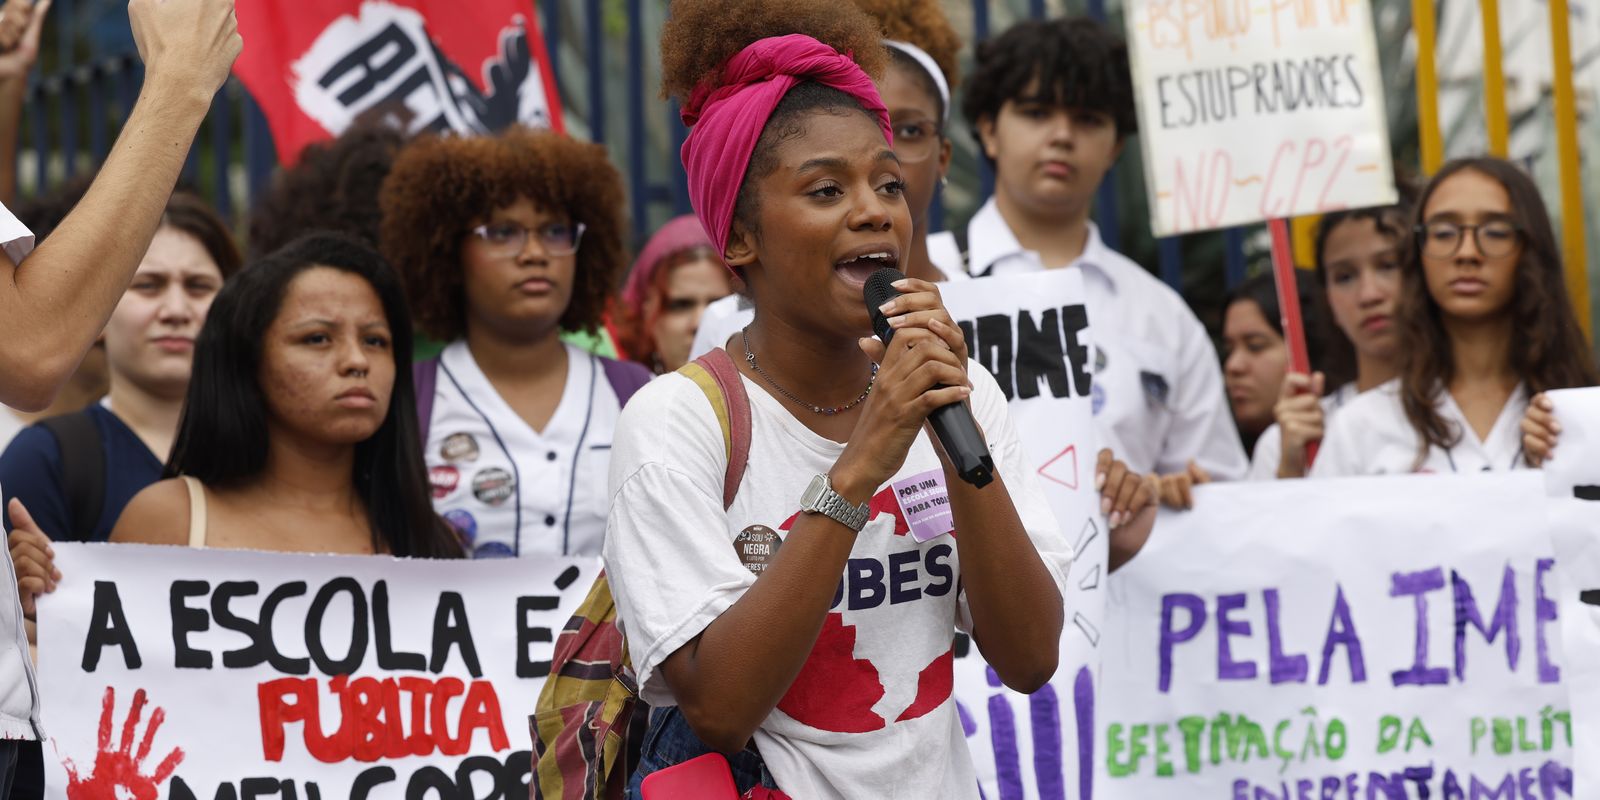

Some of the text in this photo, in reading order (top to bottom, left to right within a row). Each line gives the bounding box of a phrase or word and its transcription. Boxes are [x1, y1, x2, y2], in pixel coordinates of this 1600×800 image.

[1156, 54, 1364, 129] ESTUPRADORES
[1174, 134, 1355, 232] NO CP2
[899, 478, 938, 497] POR UMA
[907, 501, 931, 515] PARA
[743, 543, 770, 555] NEGRA
[752, 533, 764, 542] SOU
[81, 565, 580, 678] A ESCOLA É
[1158, 557, 1561, 693] PELA IME
[1376, 714, 1433, 754] DA
